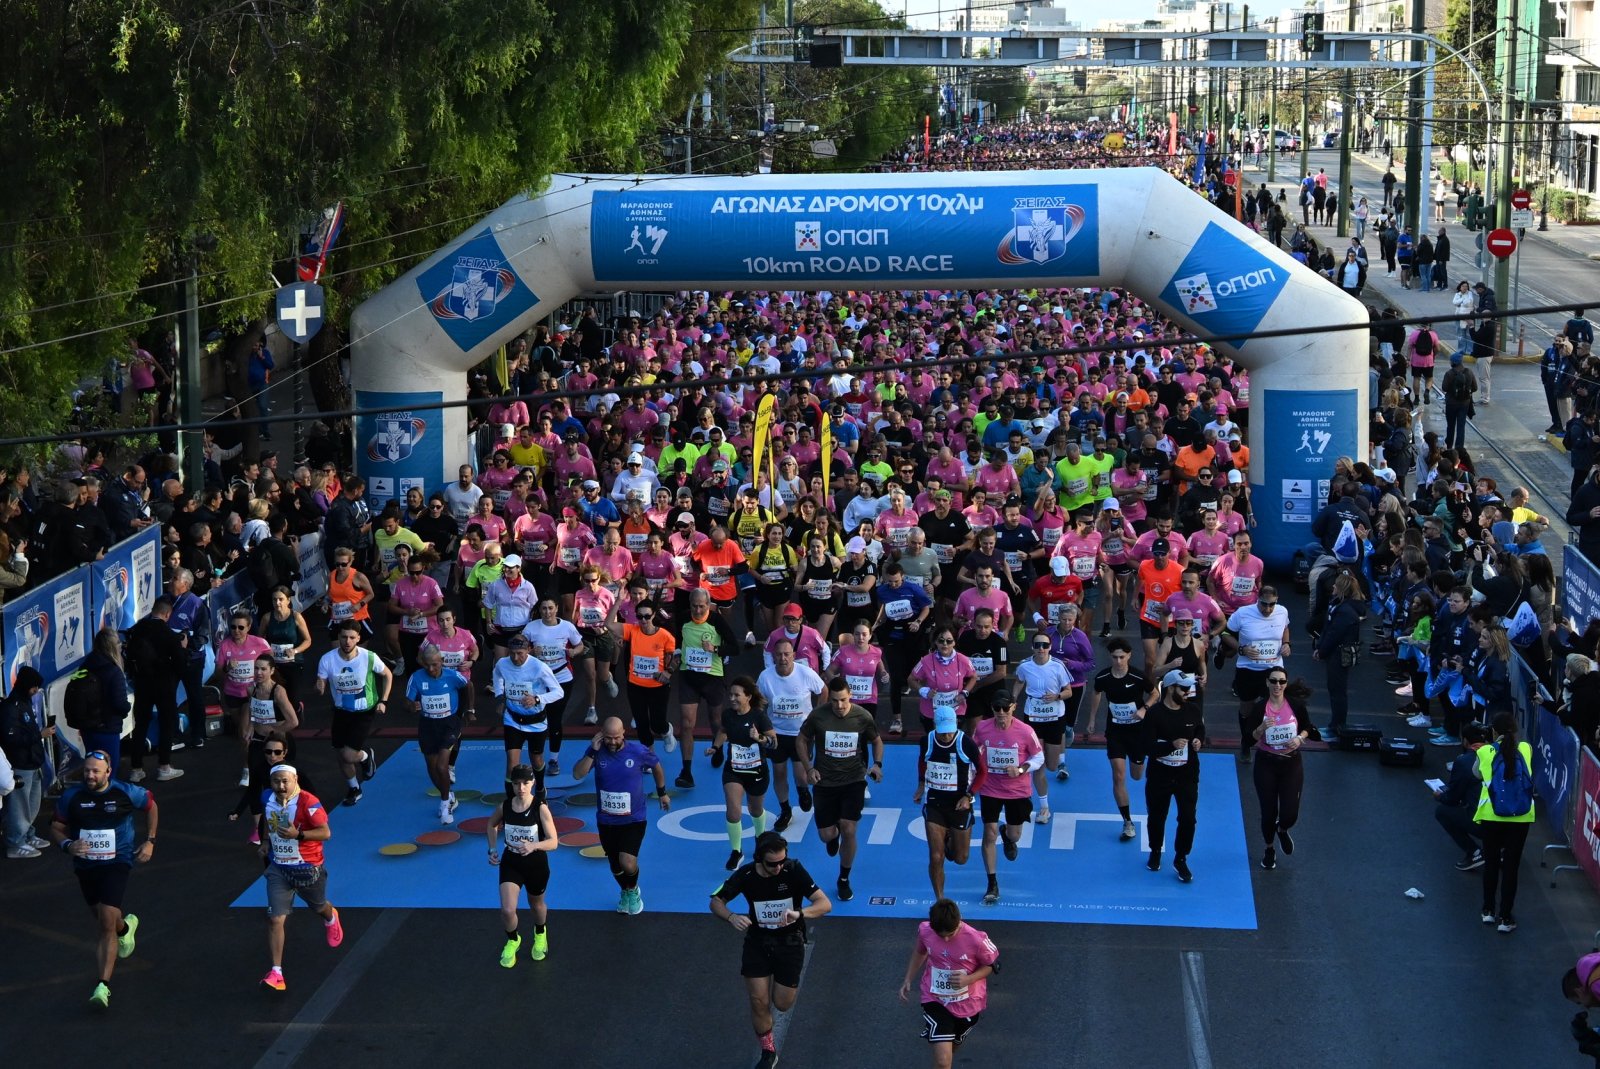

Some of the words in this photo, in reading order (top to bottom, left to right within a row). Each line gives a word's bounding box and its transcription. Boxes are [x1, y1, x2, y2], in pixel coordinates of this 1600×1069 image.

[620, 202, 674, 210] ΜΑΡΑΘΩΝΙΟΣ
[711, 196, 805, 214] ΑΓΩΝΑΣ
[808, 194, 917, 213] ΔΡΟΜΟΥ
[917, 193, 984, 215] 10χλμ
[1014, 196, 1066, 208] ΣΕΓΑΣ
[456, 256, 500, 270] ΣΕΓΑΣ
[743, 256, 805, 273] 10km
[810, 256, 881, 273] ROAD
[888, 255, 954, 272] RACE
[426, 702, 447, 710] 38188
[1270, 733, 1293, 741] 38047
[930, 772, 952, 780] 38127
[604, 800, 626, 808] 38338
